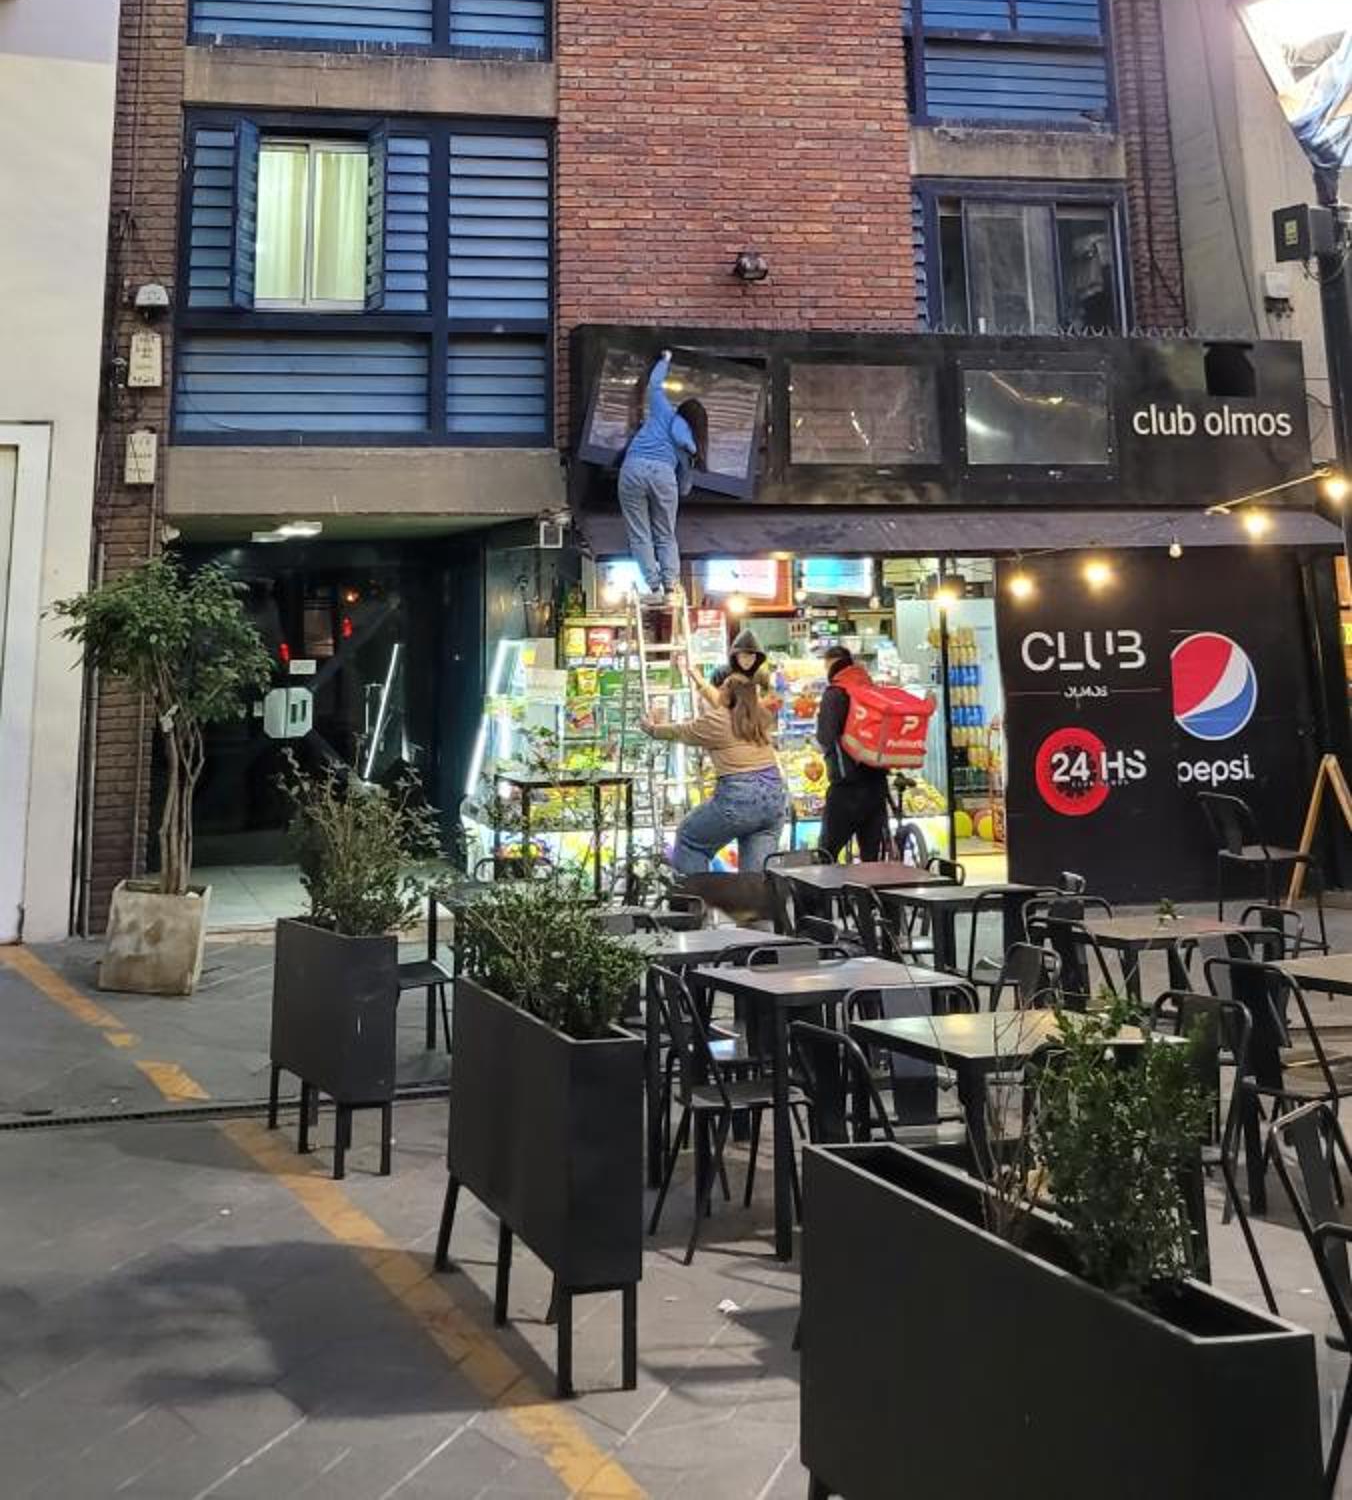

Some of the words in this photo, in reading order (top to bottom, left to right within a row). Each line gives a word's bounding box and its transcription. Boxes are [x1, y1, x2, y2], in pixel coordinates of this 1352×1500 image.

[1133, 404, 1196, 436] club
[1205, 405, 1292, 437] olmos
[1021, 629, 1147, 672] CLUB
[1051, 751, 1091, 782] 24
[1100, 749, 1147, 781] HS
